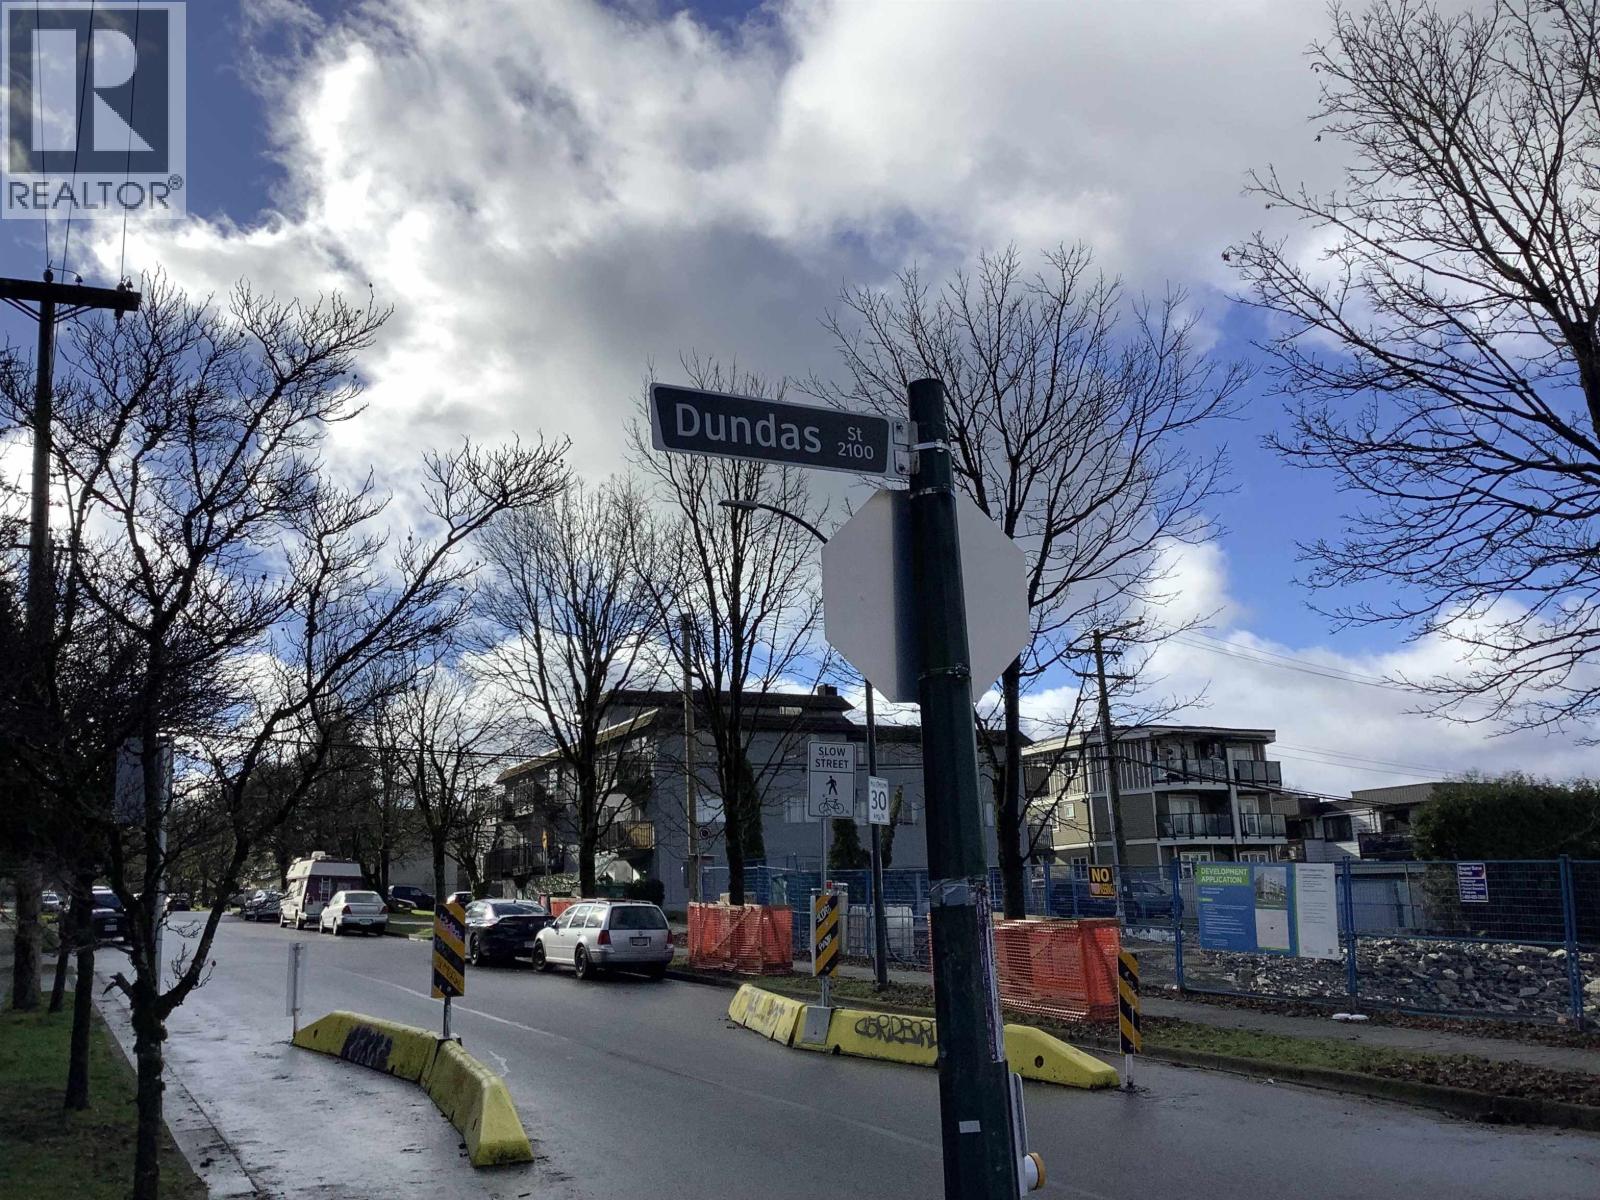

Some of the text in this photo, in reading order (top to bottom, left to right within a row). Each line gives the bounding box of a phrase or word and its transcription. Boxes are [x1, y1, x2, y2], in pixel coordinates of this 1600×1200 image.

[675, 403, 863, 453] Dundas St
[837, 442, 875, 460] 2100
[818, 746, 846, 756] SLOW
[815, 758, 849, 769] STREET
[871, 790, 887, 811] 30
[1091, 868, 1110, 882] NO
[1200, 867, 1249, 876] DEVELOPMENT
[1200, 876, 1242, 884] APPLICATION
